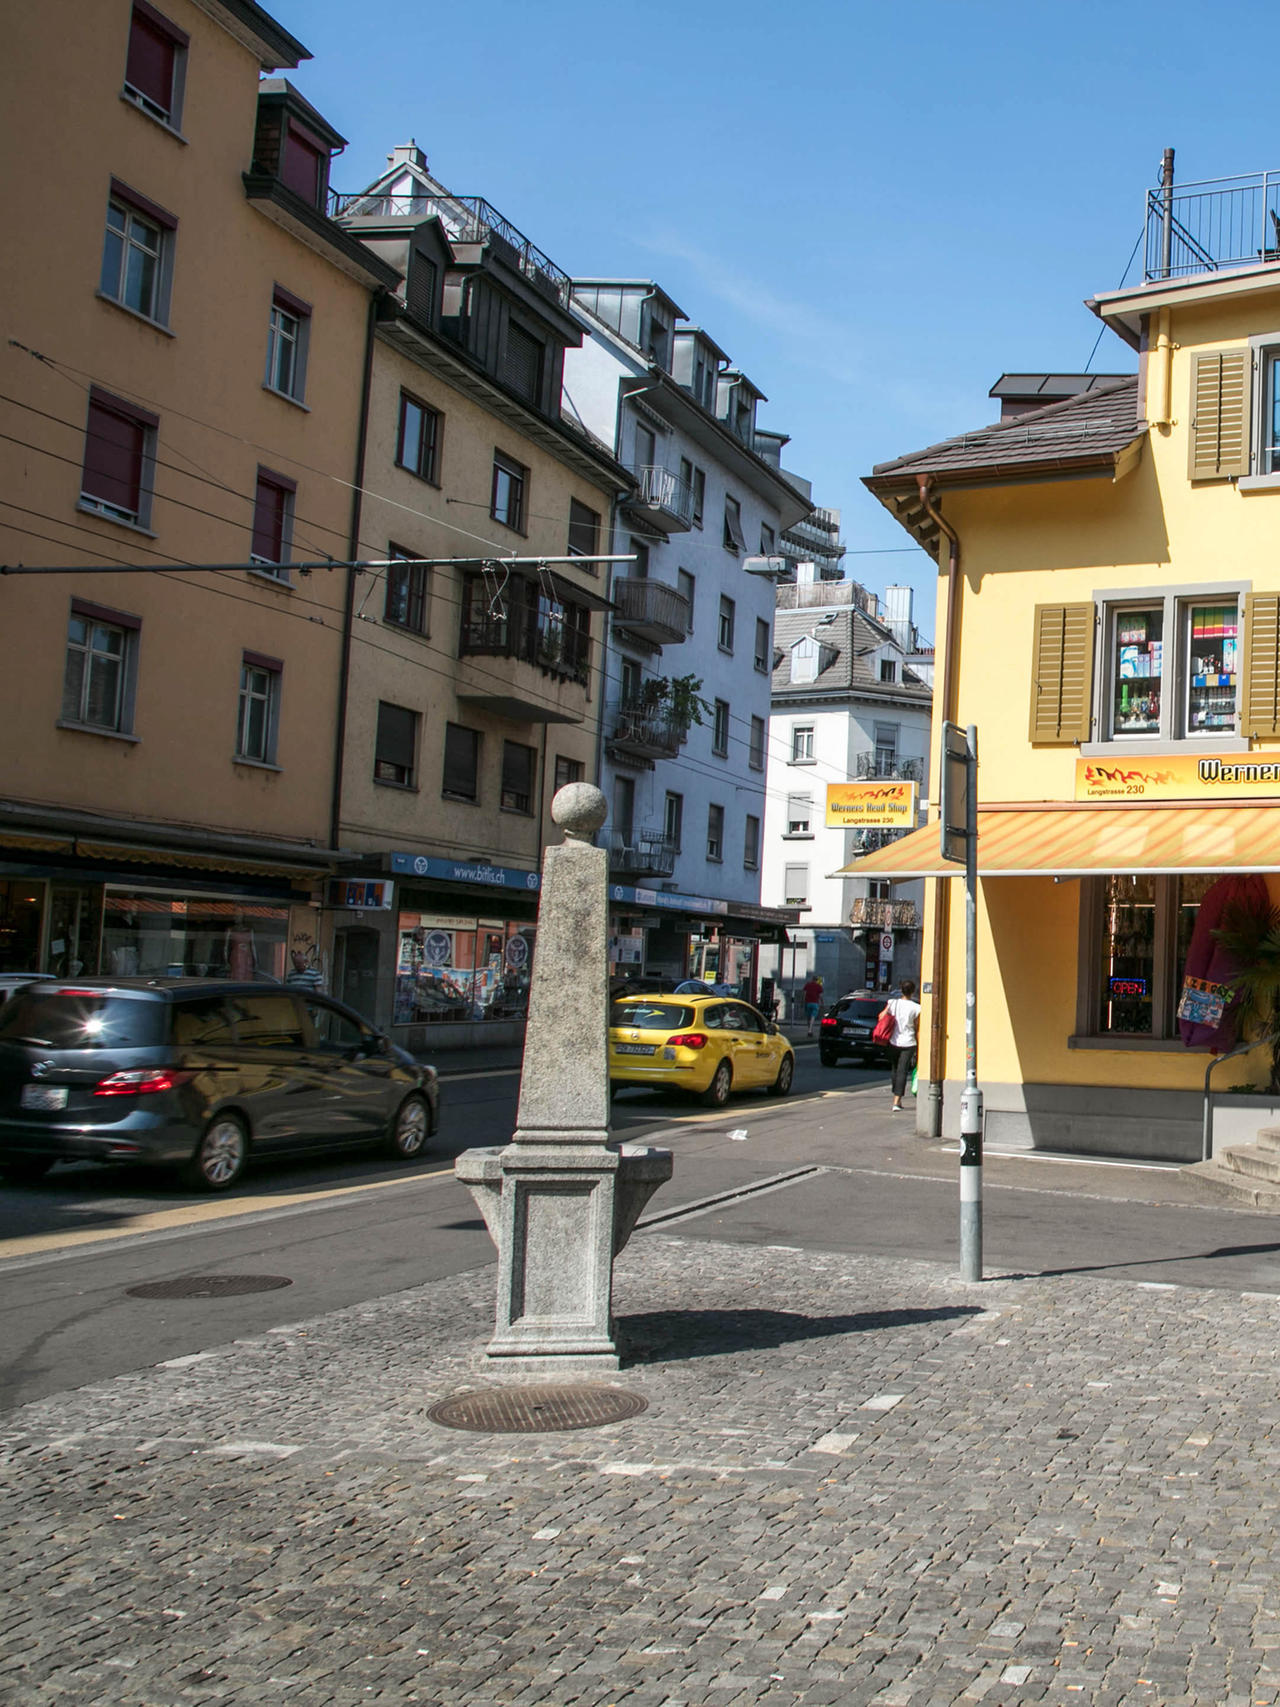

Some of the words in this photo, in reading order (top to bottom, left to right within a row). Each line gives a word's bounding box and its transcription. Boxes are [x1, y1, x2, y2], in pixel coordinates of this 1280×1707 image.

[1087, 788, 1125, 796] Langstrasse
[1126, 785, 1144, 794] 230
[831, 803, 864, 813] Werners
[888, 803, 907, 815] Shop
[1113, 981, 1143, 994] OPEN
